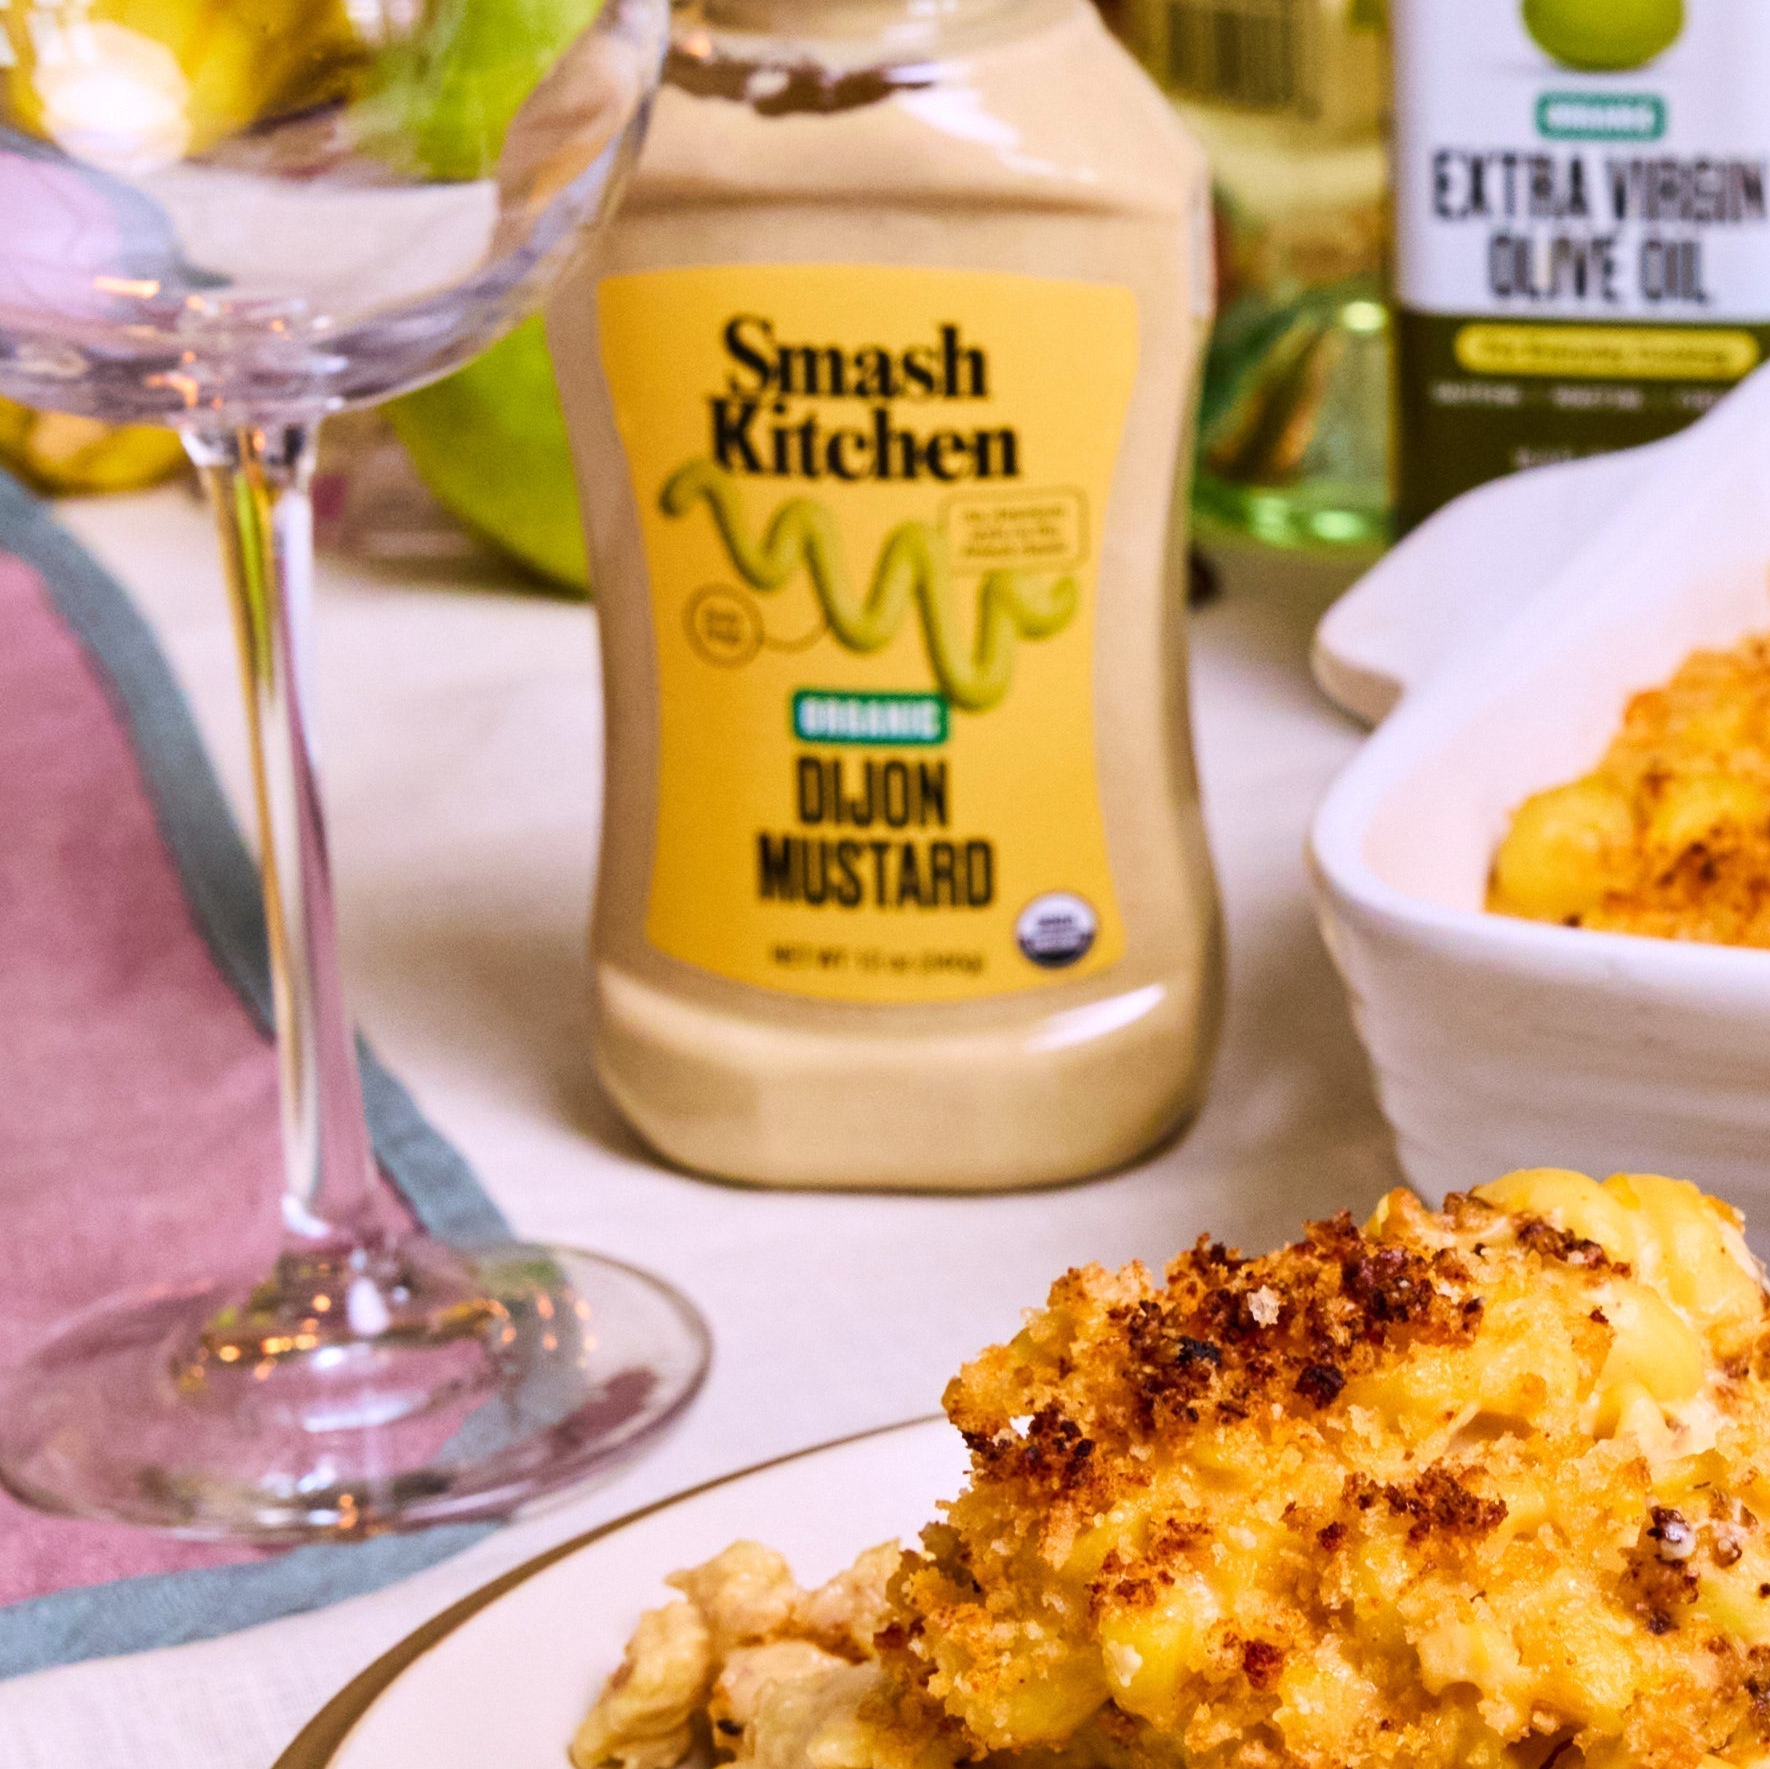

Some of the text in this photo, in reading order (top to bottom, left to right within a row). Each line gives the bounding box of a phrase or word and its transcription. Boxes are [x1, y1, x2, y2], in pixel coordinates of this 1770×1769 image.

[1432, 149, 1589, 222] EXTRA
[1488, 231, 1711, 305] OLIVE OIL
[722, 313, 992, 397] Smash
[709, 396, 1021, 481] Kitchen
[796, 755, 948, 828] DIJON
[757, 833, 995, 908] MUSTARD
